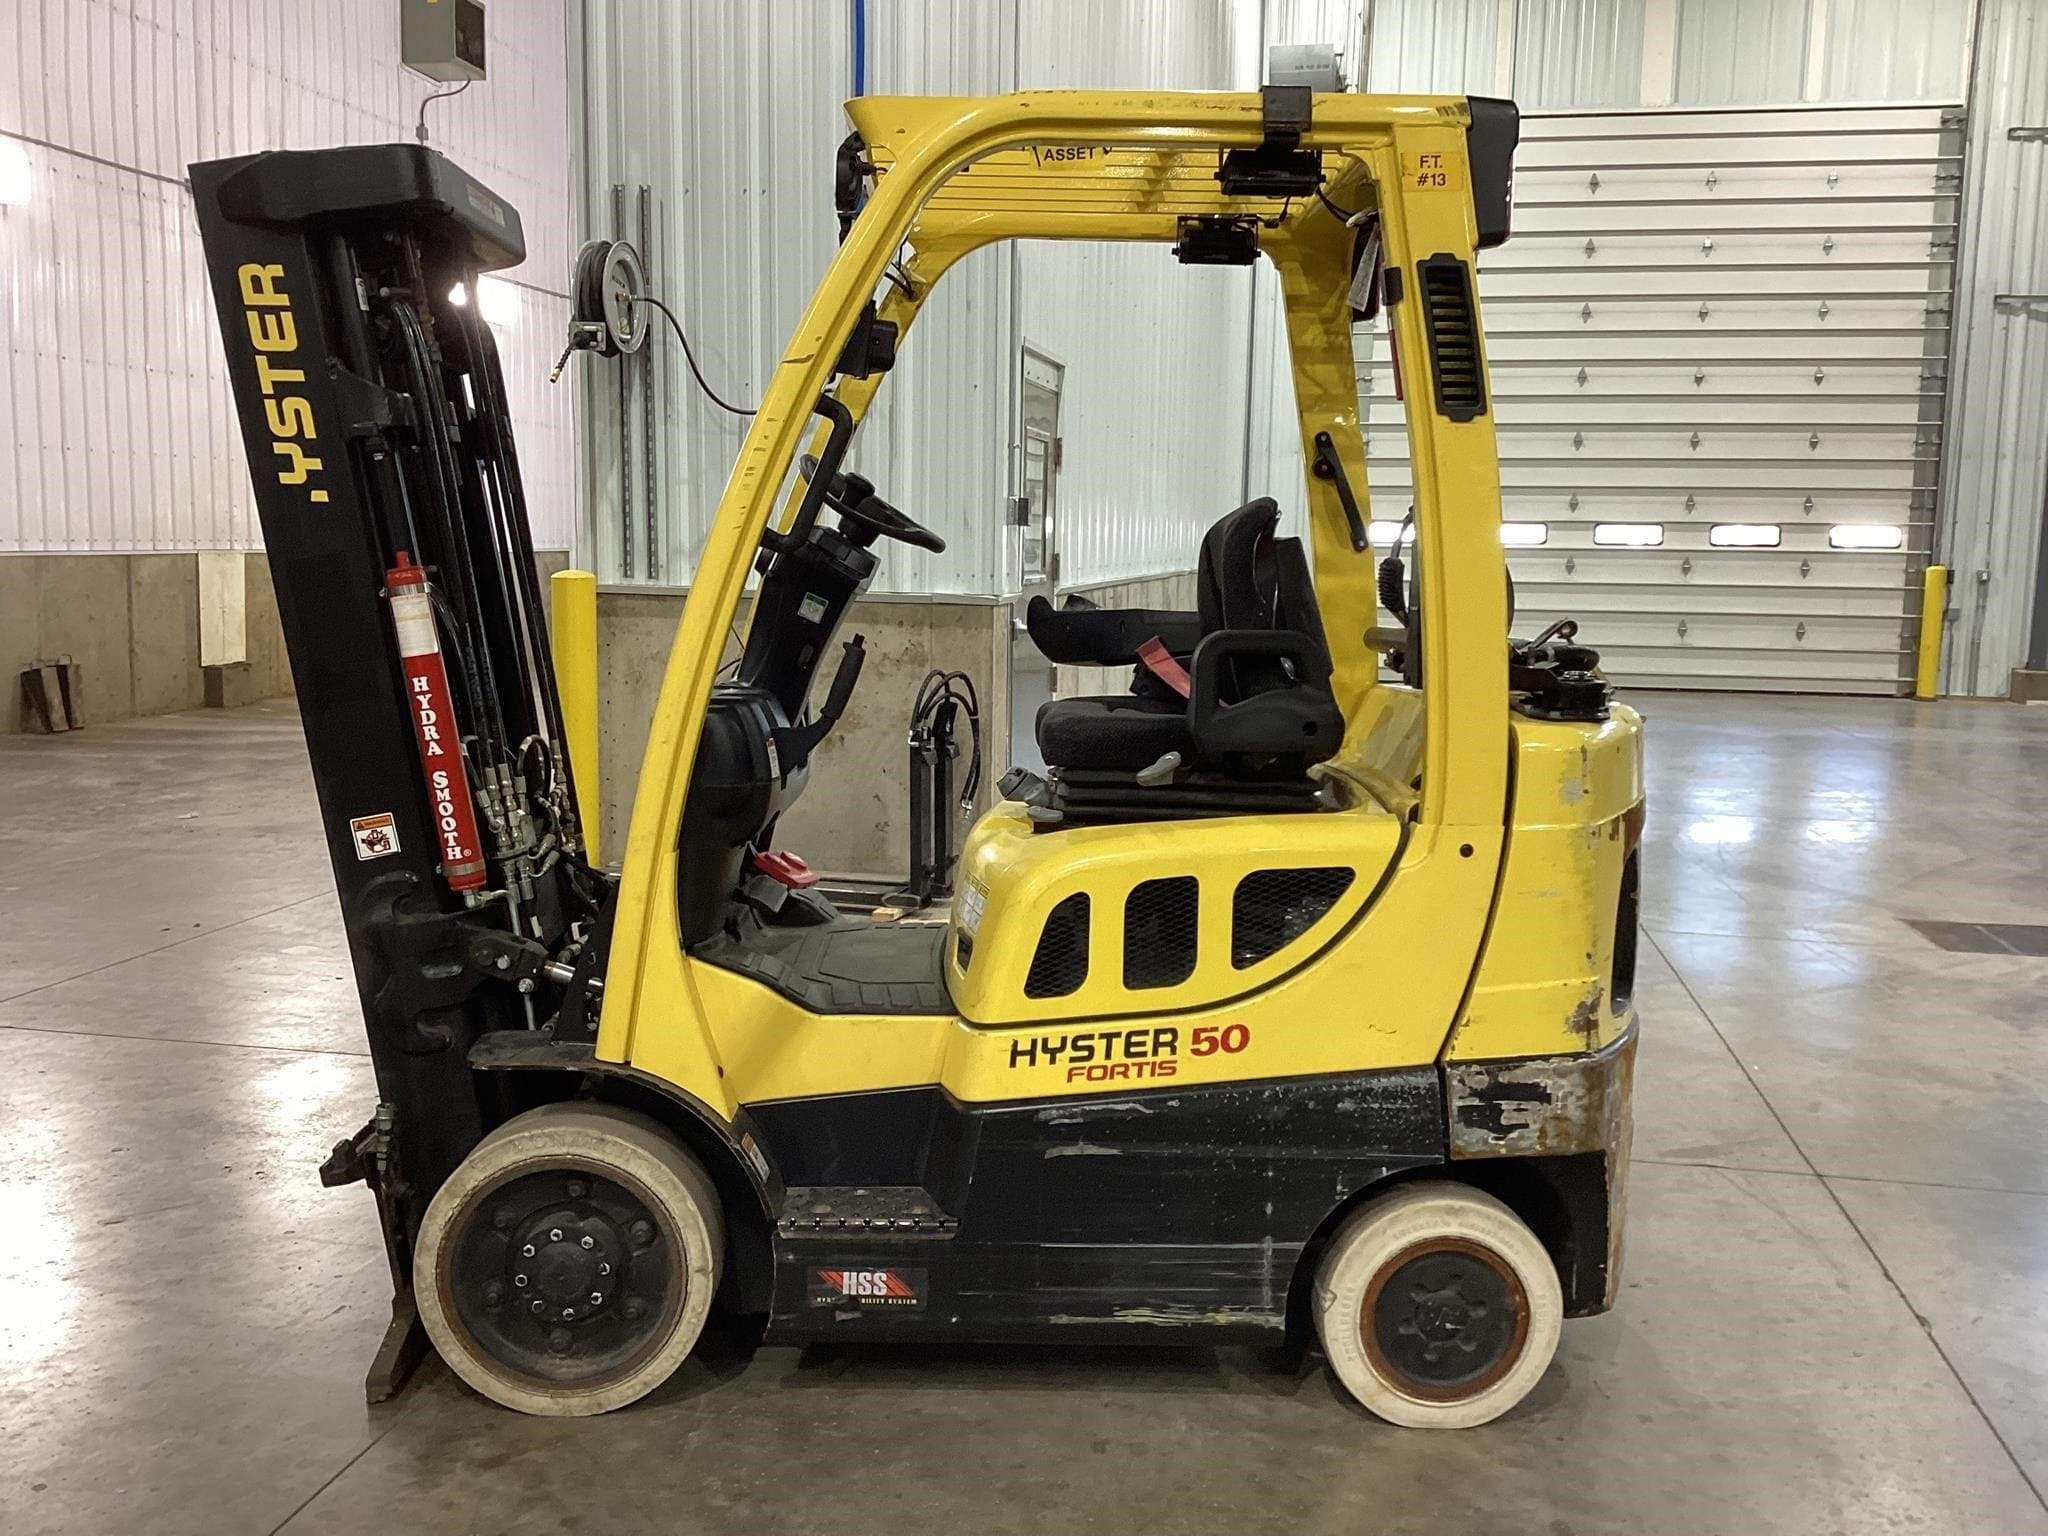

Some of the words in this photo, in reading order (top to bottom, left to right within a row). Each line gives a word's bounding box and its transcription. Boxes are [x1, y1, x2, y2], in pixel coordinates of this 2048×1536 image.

[1043, 146, 1096, 162] ASSET
[1419, 154, 1444, 169] F.T.
[1416, 172, 1447, 187] #13
[238, 263, 330, 503] YSTER
[412, 676, 444, 756] HYDRA
[1008, 1026, 1179, 1068] HYSTER
[1189, 1023, 1251, 1057] 50
[1066, 1059, 1178, 1083] FORTIS
[842, 1271, 888, 1296] HSS
